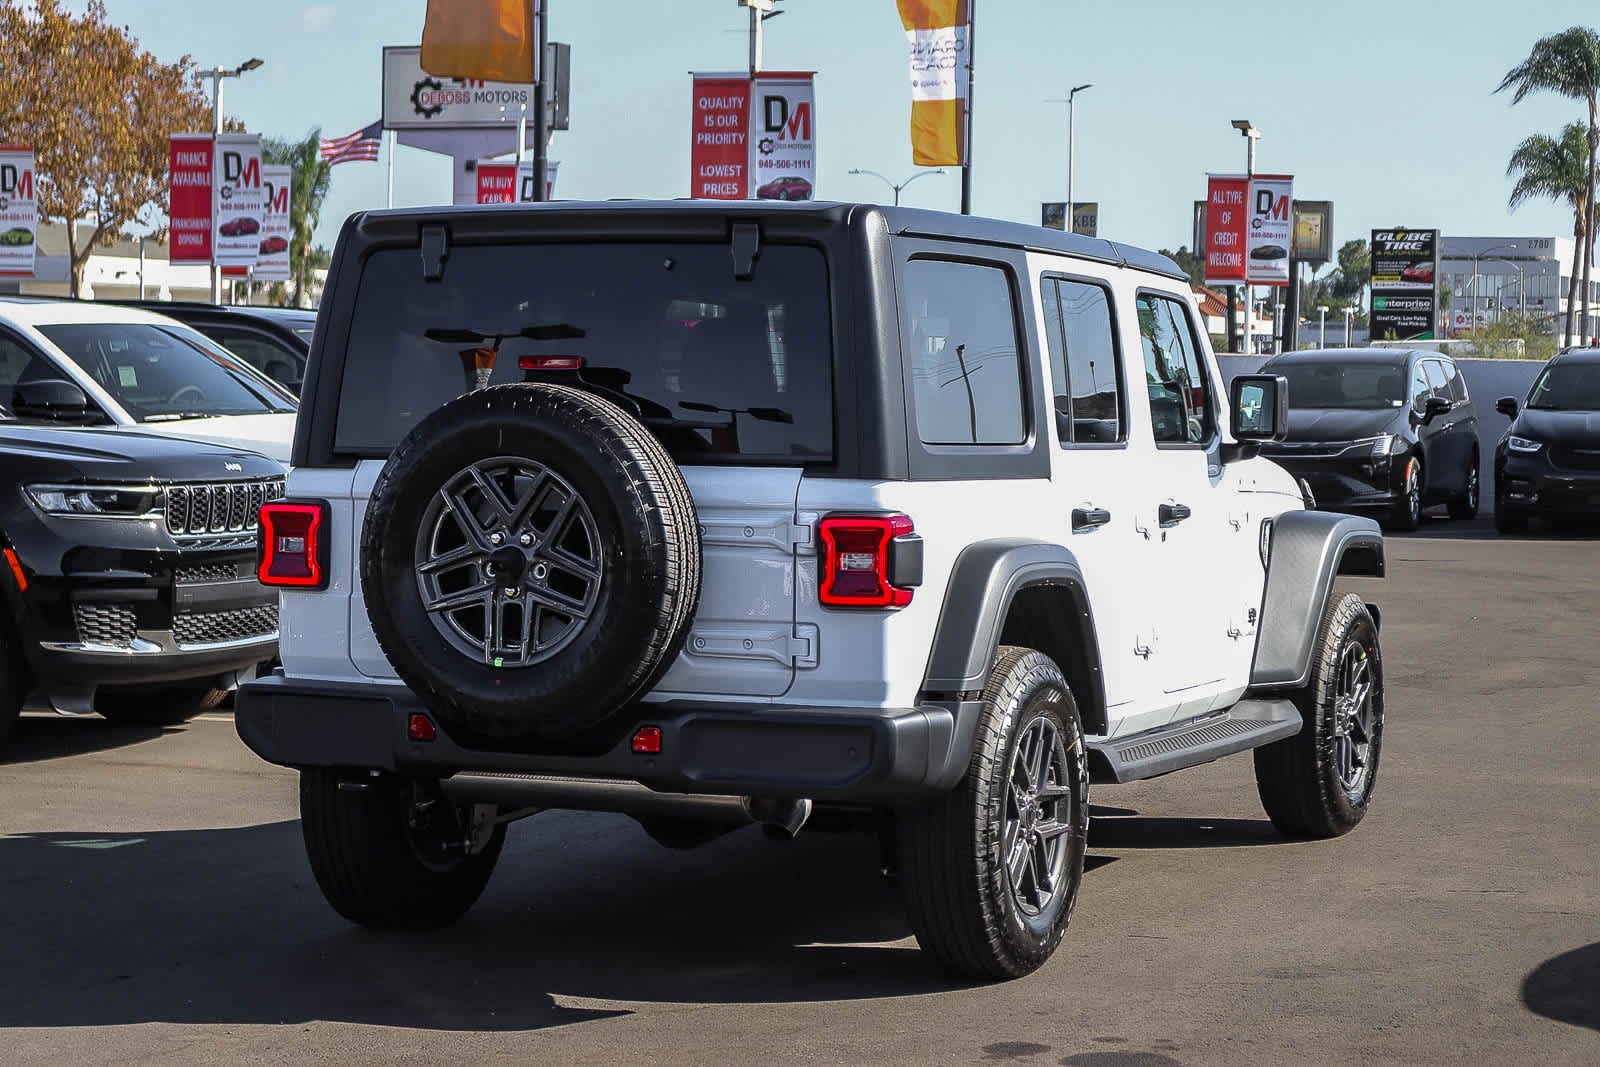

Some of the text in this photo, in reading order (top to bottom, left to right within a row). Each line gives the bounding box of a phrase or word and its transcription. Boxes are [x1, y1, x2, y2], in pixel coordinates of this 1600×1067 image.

[421, 90, 528, 105] DEBOSS MOTORS
[699, 96, 744, 110] QUALITY
[704, 114, 738, 127] IS OUR
[697, 132, 745, 145] PRIORITY
[176, 152, 207, 166] FINANCE
[700, 165, 742, 177] LOWEST
[482, 175, 513, 189] WE BUY
[703, 182, 739, 195] PRICES
[1213, 190, 1243, 205] ALL TYPE
[1074, 215, 1097, 227] KBB
[1222, 211, 1232, 225] OF
[1214, 232, 1238, 246] CREDIT
[1376, 232, 1432, 241] GLOBE
[1384, 241, 1424, 250] TIRE
[1209, 253, 1242, 267] WELCOME
[1377, 299, 1431, 309] enterprise
